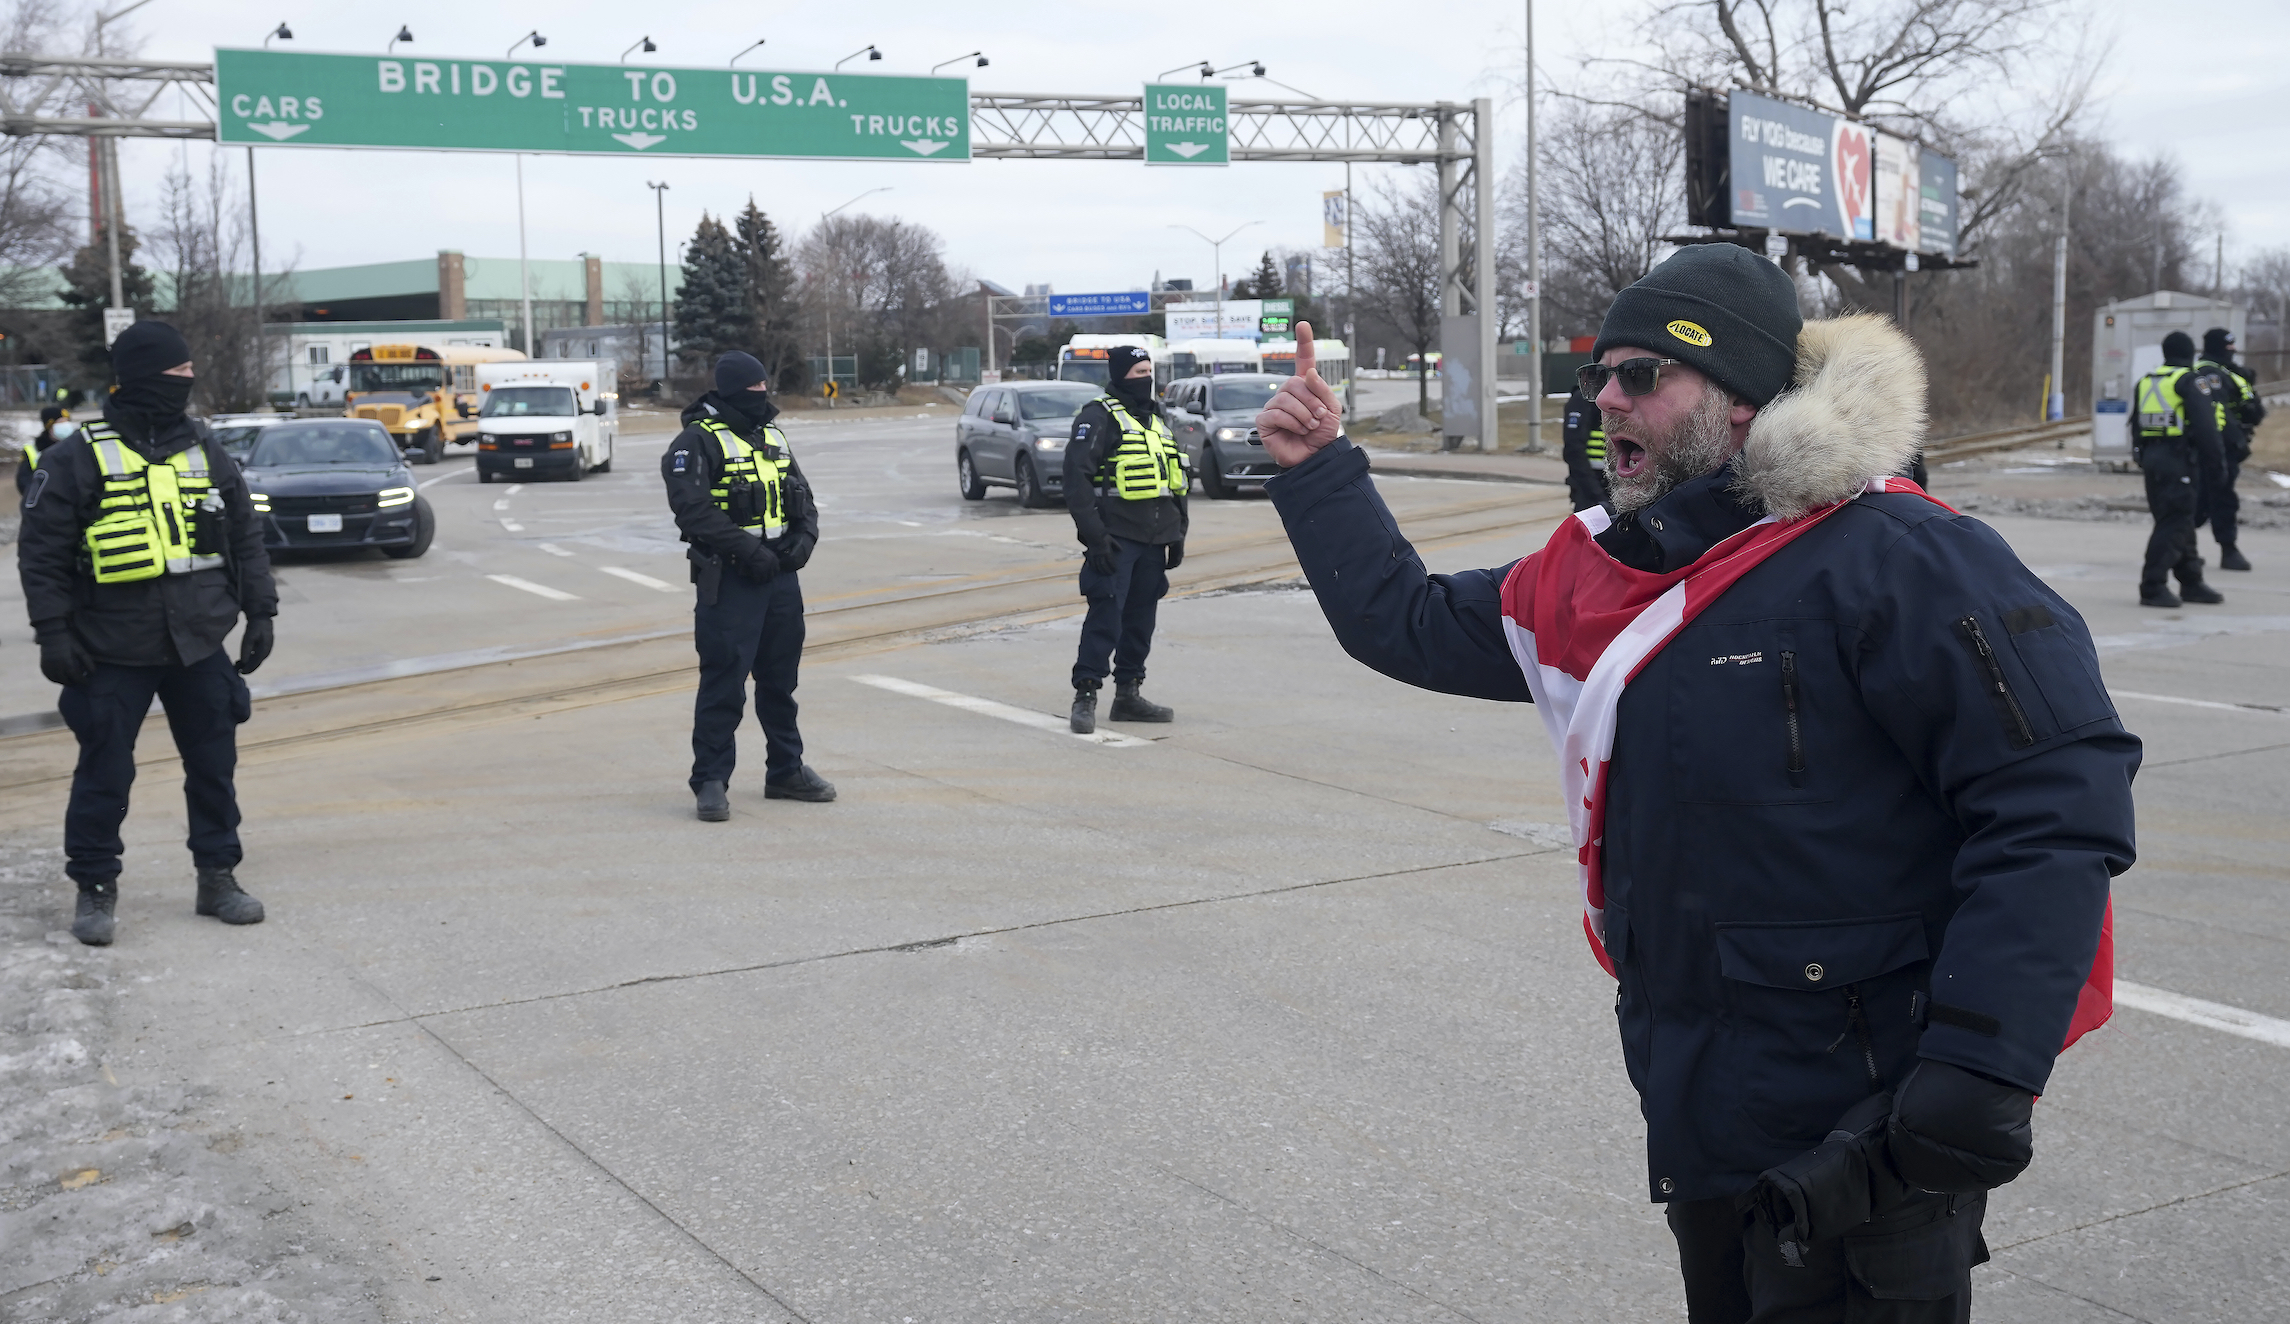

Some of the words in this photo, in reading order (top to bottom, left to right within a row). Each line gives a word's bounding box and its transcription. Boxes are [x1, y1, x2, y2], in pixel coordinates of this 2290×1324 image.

[378, 60, 566, 99] BRIDGE
[624, 71, 677, 103] TO
[731, 74, 848, 108] U.S.A.
[232, 93, 324, 120] CARS
[1156, 93, 1216, 111] LOCAL
[577, 106, 698, 131] TRUCKS
[850, 114, 959, 137] TRUCKS
[1149, 116, 1224, 133] TRAFFIC
[1741, 115, 1761, 143] FLY
[1762, 154, 1787, 189] WE
[1786, 159, 1821, 195] CARE
[1066, 296, 1098, 304] BRIDGE
[1101, 296, 1112, 304] TO
[1113, 295, 1132, 303] USA
[1263, 301, 1290, 312] DIESEL
[1674, 323, 1705, 343] LOCATE
